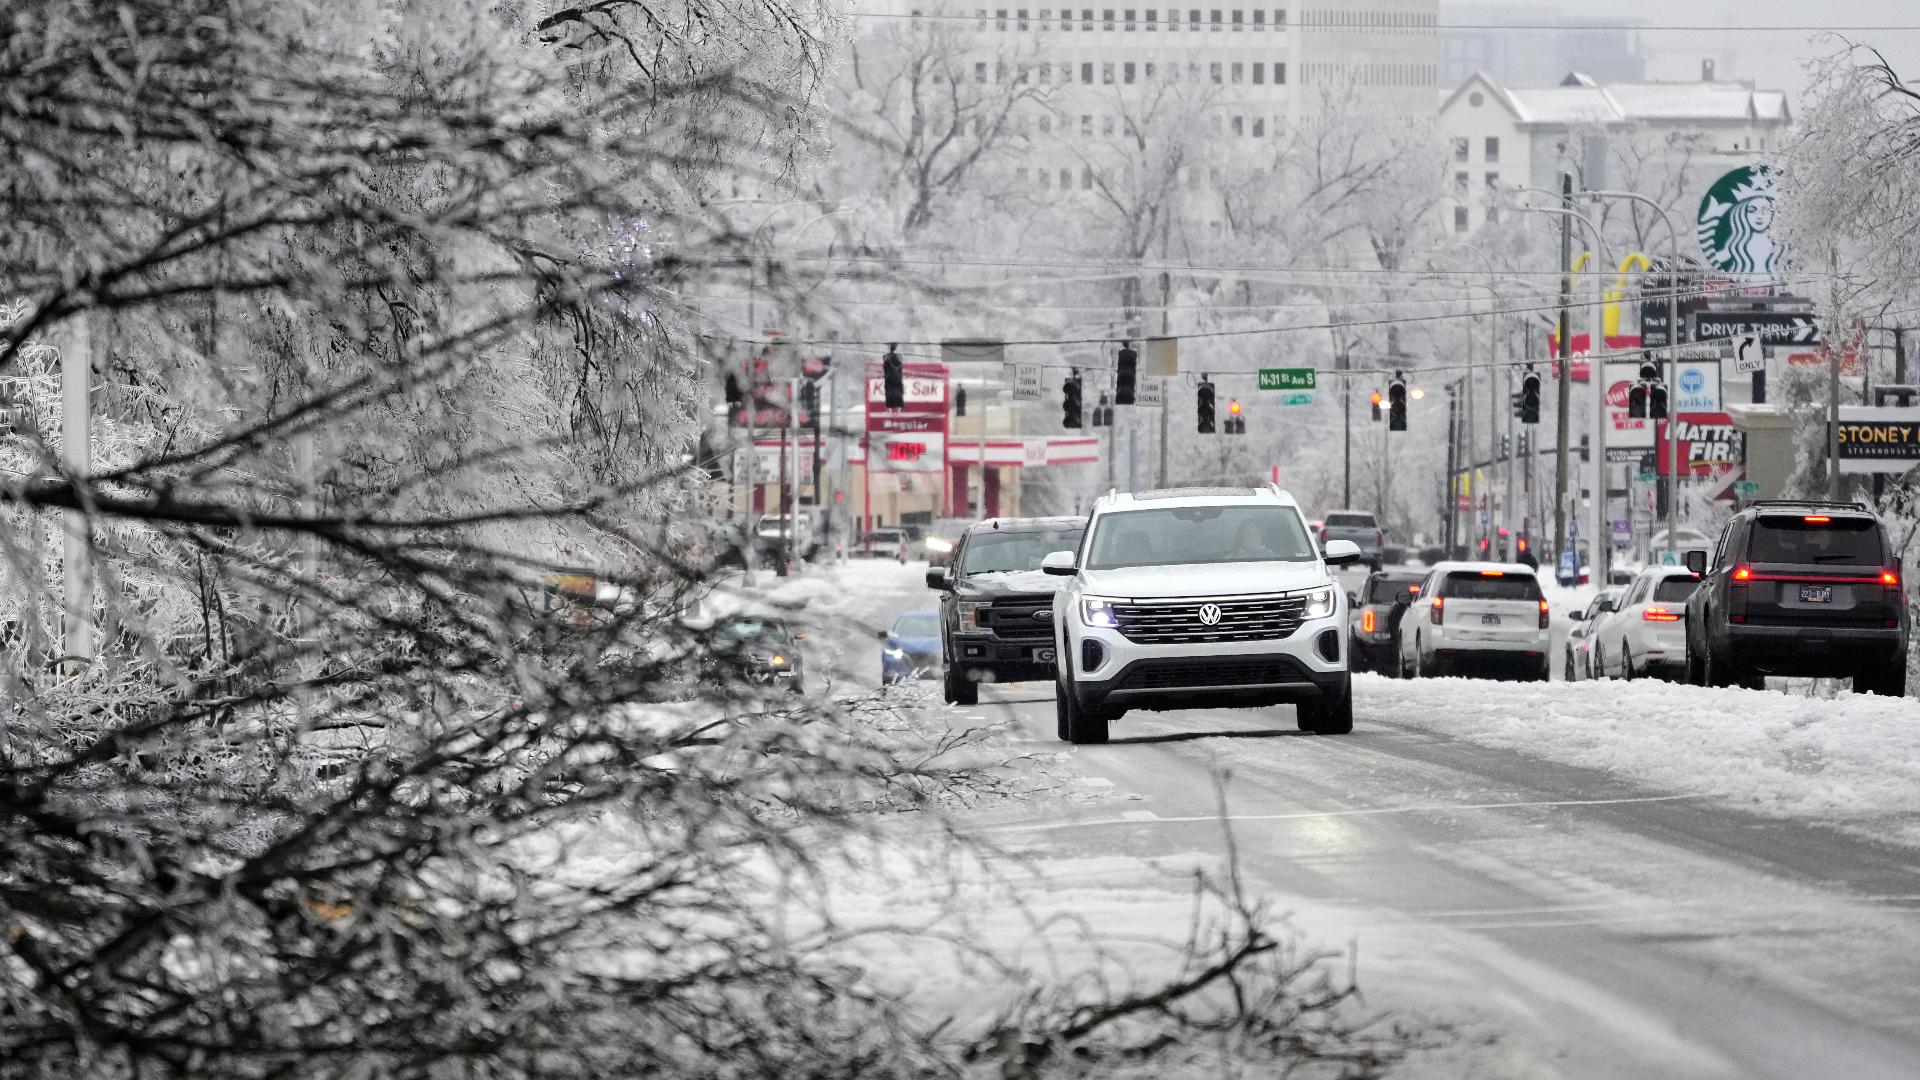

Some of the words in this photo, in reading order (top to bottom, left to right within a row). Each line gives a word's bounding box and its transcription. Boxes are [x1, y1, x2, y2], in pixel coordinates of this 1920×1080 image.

[1701, 323, 1745, 336] DRIVE
[1750, 324, 1790, 336] THRU
[1739, 360, 1761, 370] ONLY
[1020, 378, 1037, 386] TURN
[1306, 372, 1314, 385] S
[912, 382, 938, 396] Sak
[1016, 389, 1040, 397] SIGNAL
[1839, 425, 1912, 443] STONEY
[1688, 442, 1735, 461] FIR
[1848, 447, 1906, 455] STEAKHOUSE
